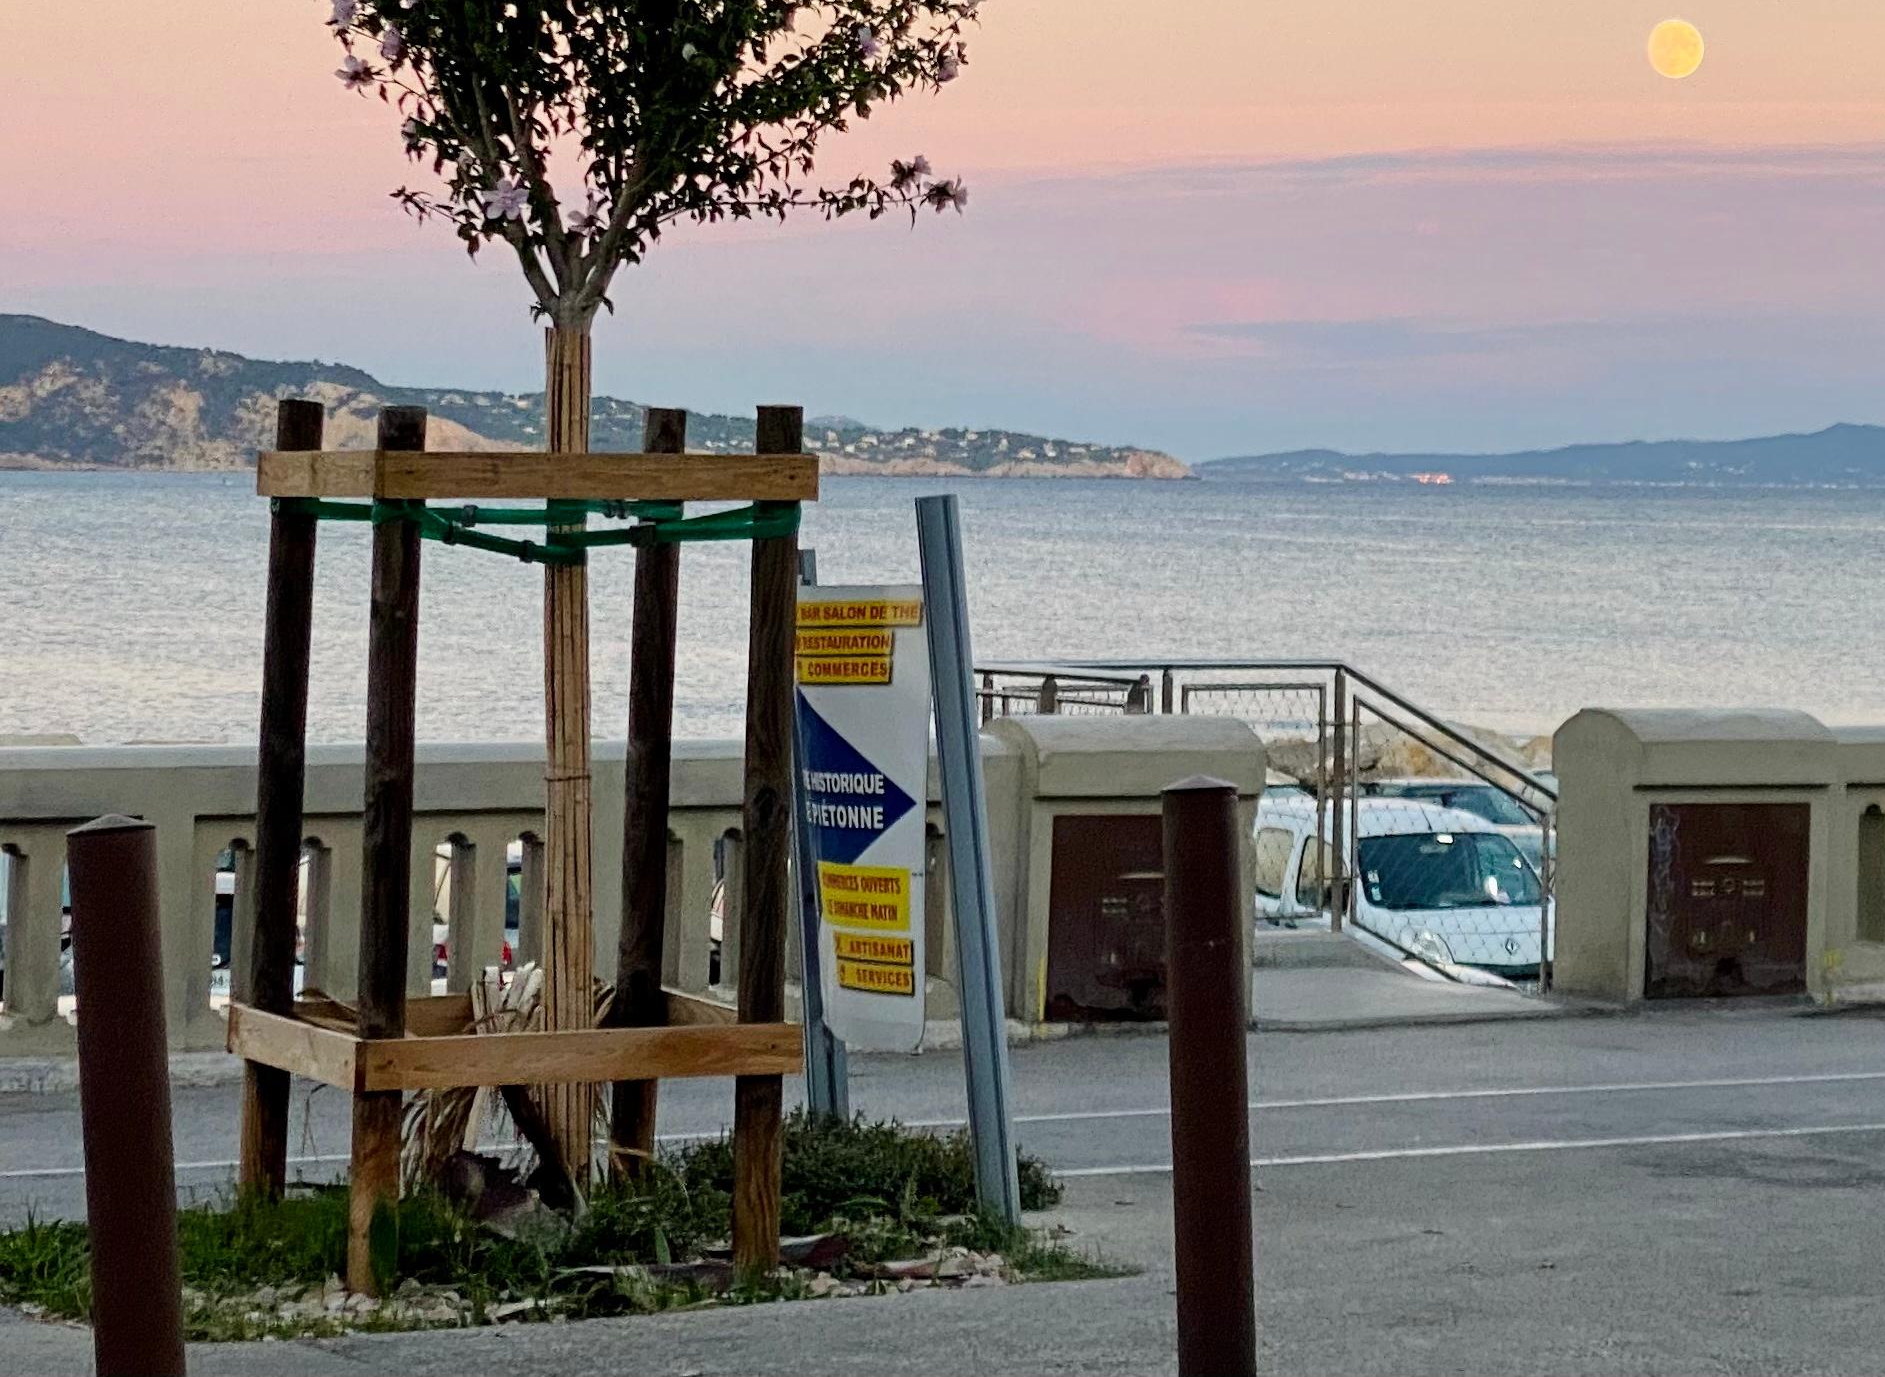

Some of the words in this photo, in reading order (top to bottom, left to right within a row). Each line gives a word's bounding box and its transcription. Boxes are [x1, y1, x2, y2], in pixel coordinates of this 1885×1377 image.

[823, 606, 867, 620] SALON
[870, 606, 887, 620] DE
[802, 635, 890, 650] RESTAURATION
[808, 661, 888, 678] COMMERCES
[811, 772, 885, 795] HISTORIQUE
[812, 799, 884, 830] PIÉTONNE
[860, 875, 902, 895] OUVERTS
[870, 902, 898, 921] MATIN
[850, 941, 910, 960] ARTISANAT
[856, 968, 911, 987] SERVICES
